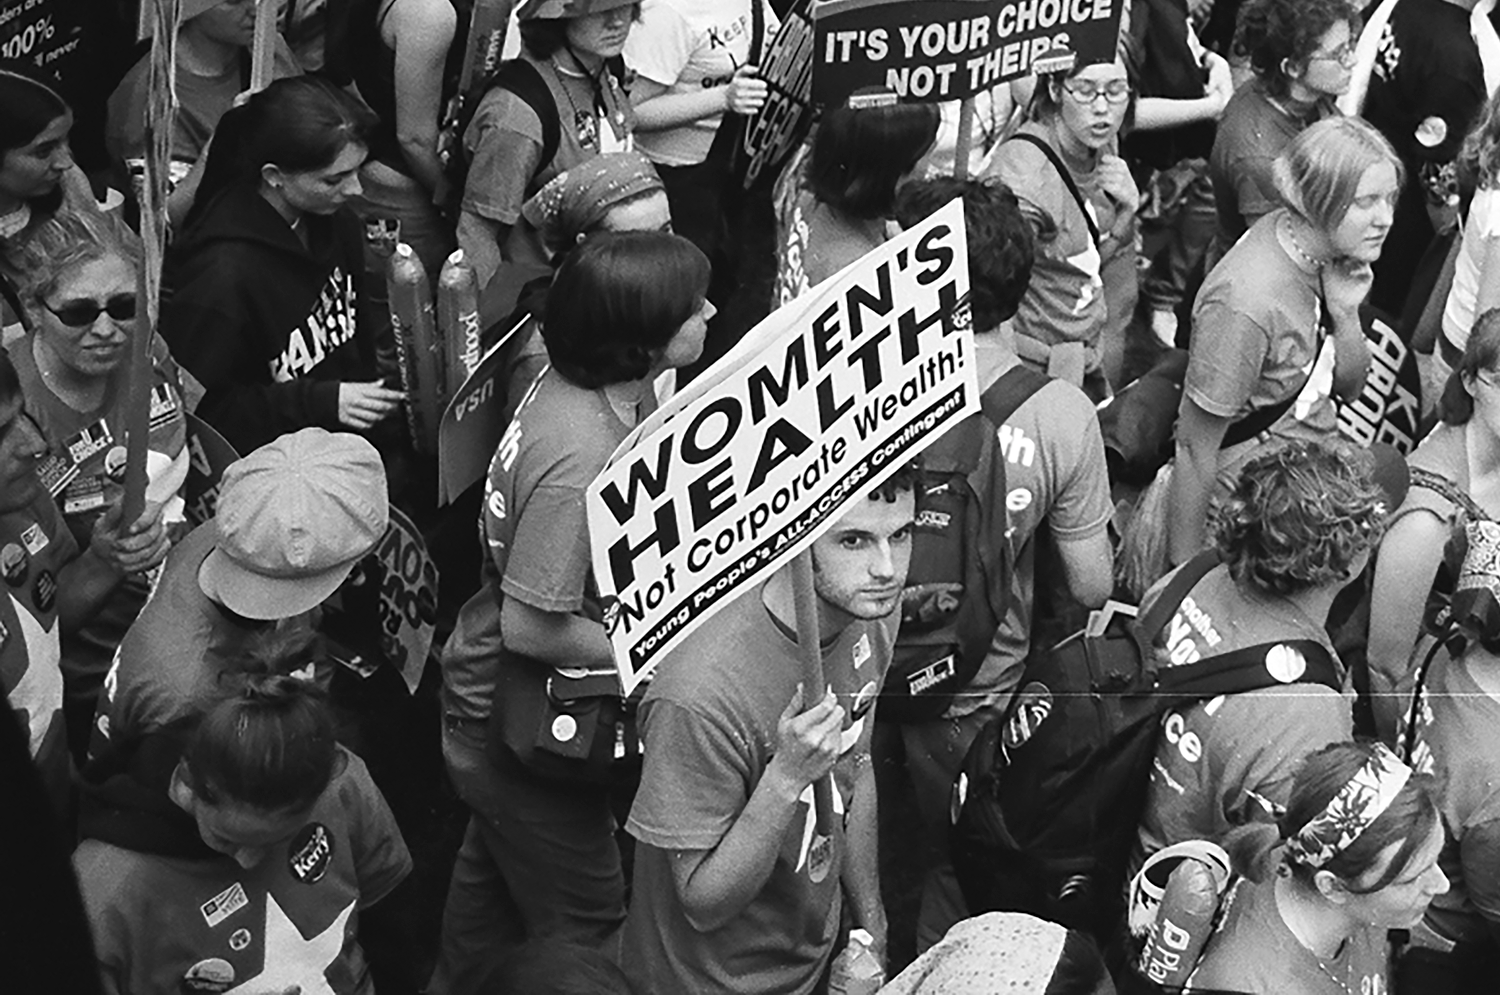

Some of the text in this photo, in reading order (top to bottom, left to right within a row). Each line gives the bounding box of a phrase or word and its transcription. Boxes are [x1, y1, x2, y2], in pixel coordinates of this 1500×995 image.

[825, 27, 890, 64] IT'S
[898, 14, 990, 59] YOUR
[885, 62, 957, 99] NOT
[599, 223, 955, 528] WOMEN'S
[607, 277, 971, 595] HEALTH
[620, 336, 966, 635] Not Corporate Wealth!
[633, 605, 691, 662] Young
[692, 548, 773, 609] People's
[773, 460, 870, 559] ALL-ACCESS
[869, 390, 964, 470] Contingent
